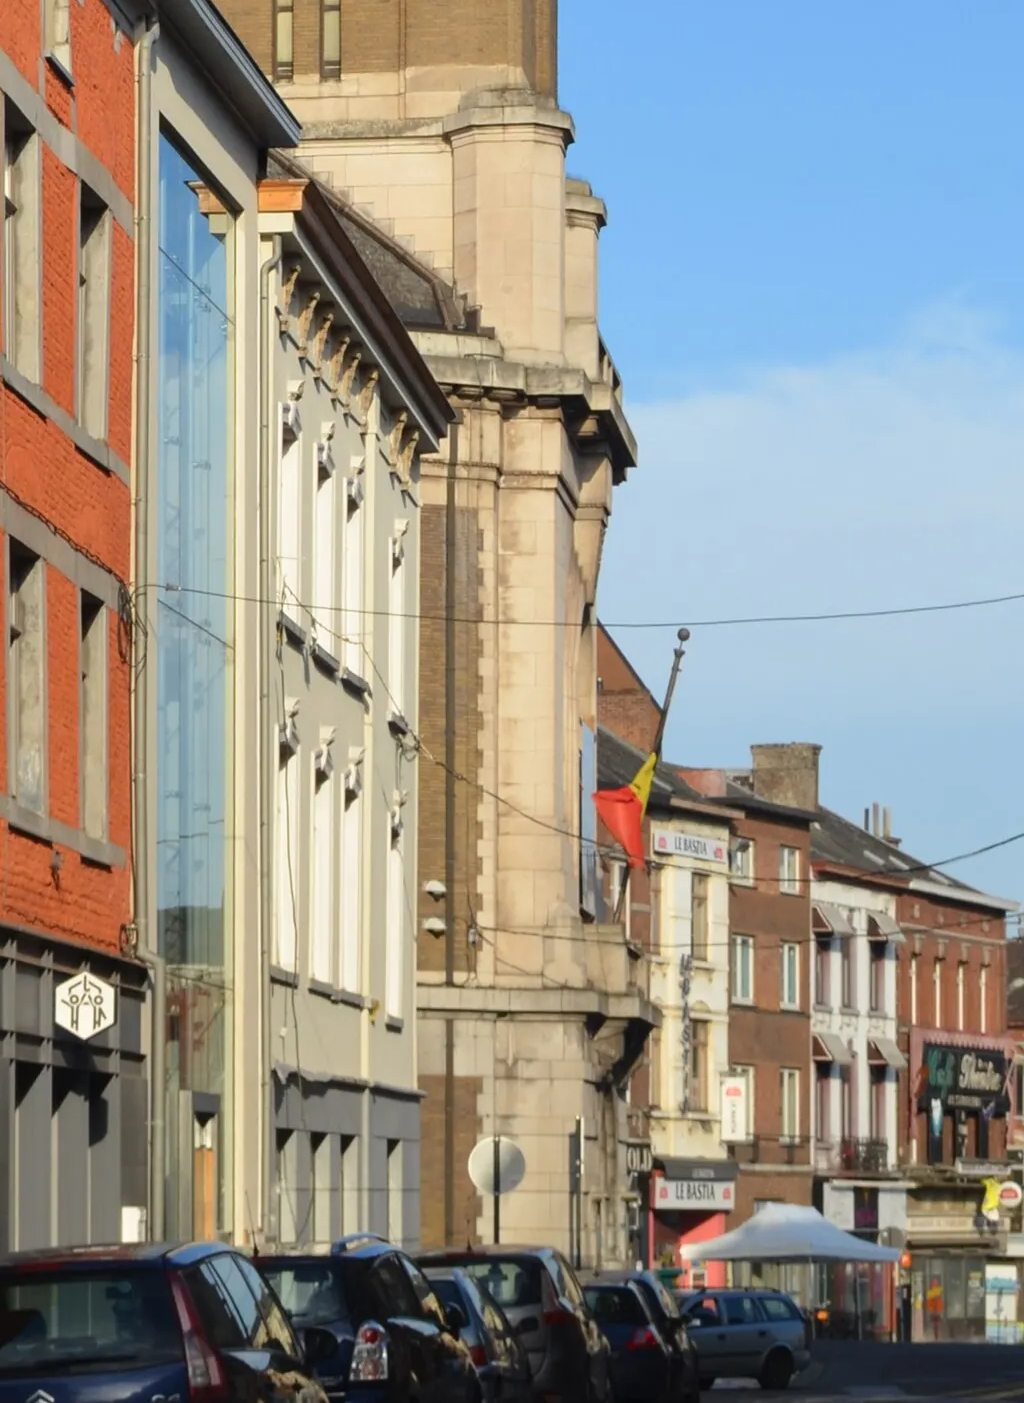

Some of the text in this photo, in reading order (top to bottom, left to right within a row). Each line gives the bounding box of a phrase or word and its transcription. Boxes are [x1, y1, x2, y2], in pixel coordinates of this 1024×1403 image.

[674, 836, 707, 855] LE BASTIA
[676, 1182, 715, 1201] LE BASTIA
